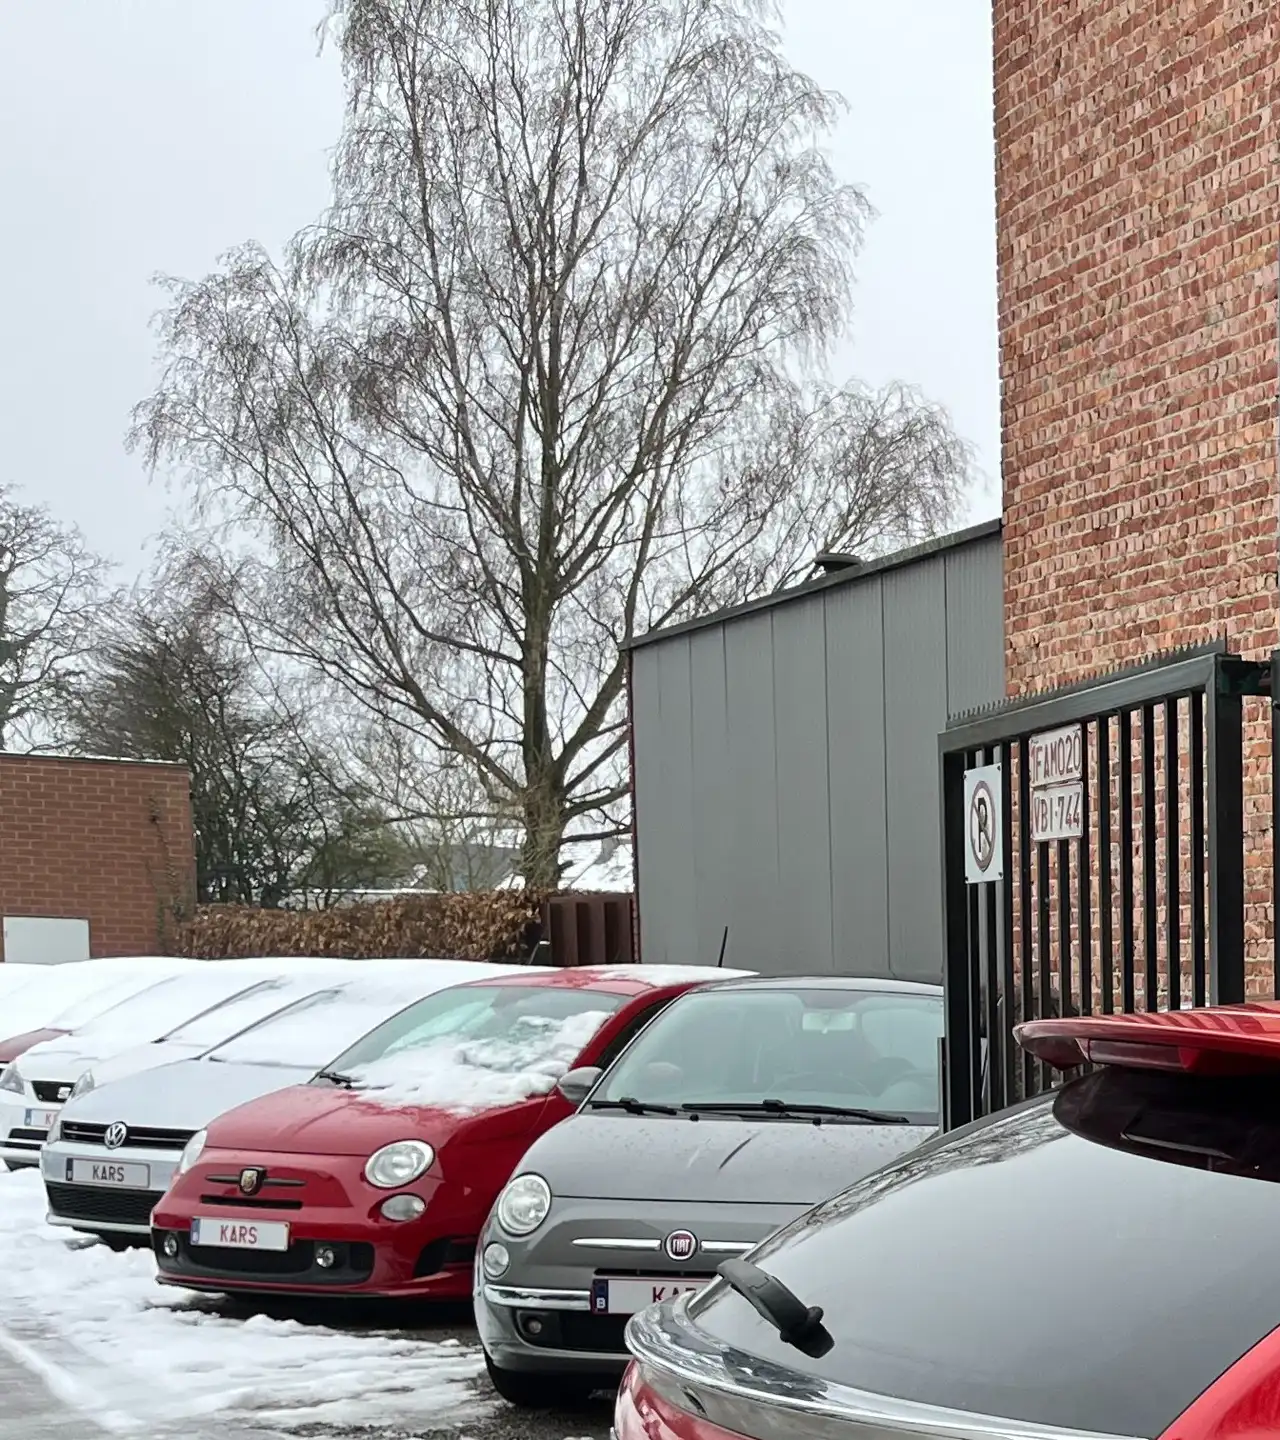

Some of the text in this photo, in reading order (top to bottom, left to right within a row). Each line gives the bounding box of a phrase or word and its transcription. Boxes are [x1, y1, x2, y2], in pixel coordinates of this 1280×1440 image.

[92, 1165, 125, 1182] KARS
[220, 1224, 258, 1244] KARS
[672, 1238, 691, 1253] FIAT
